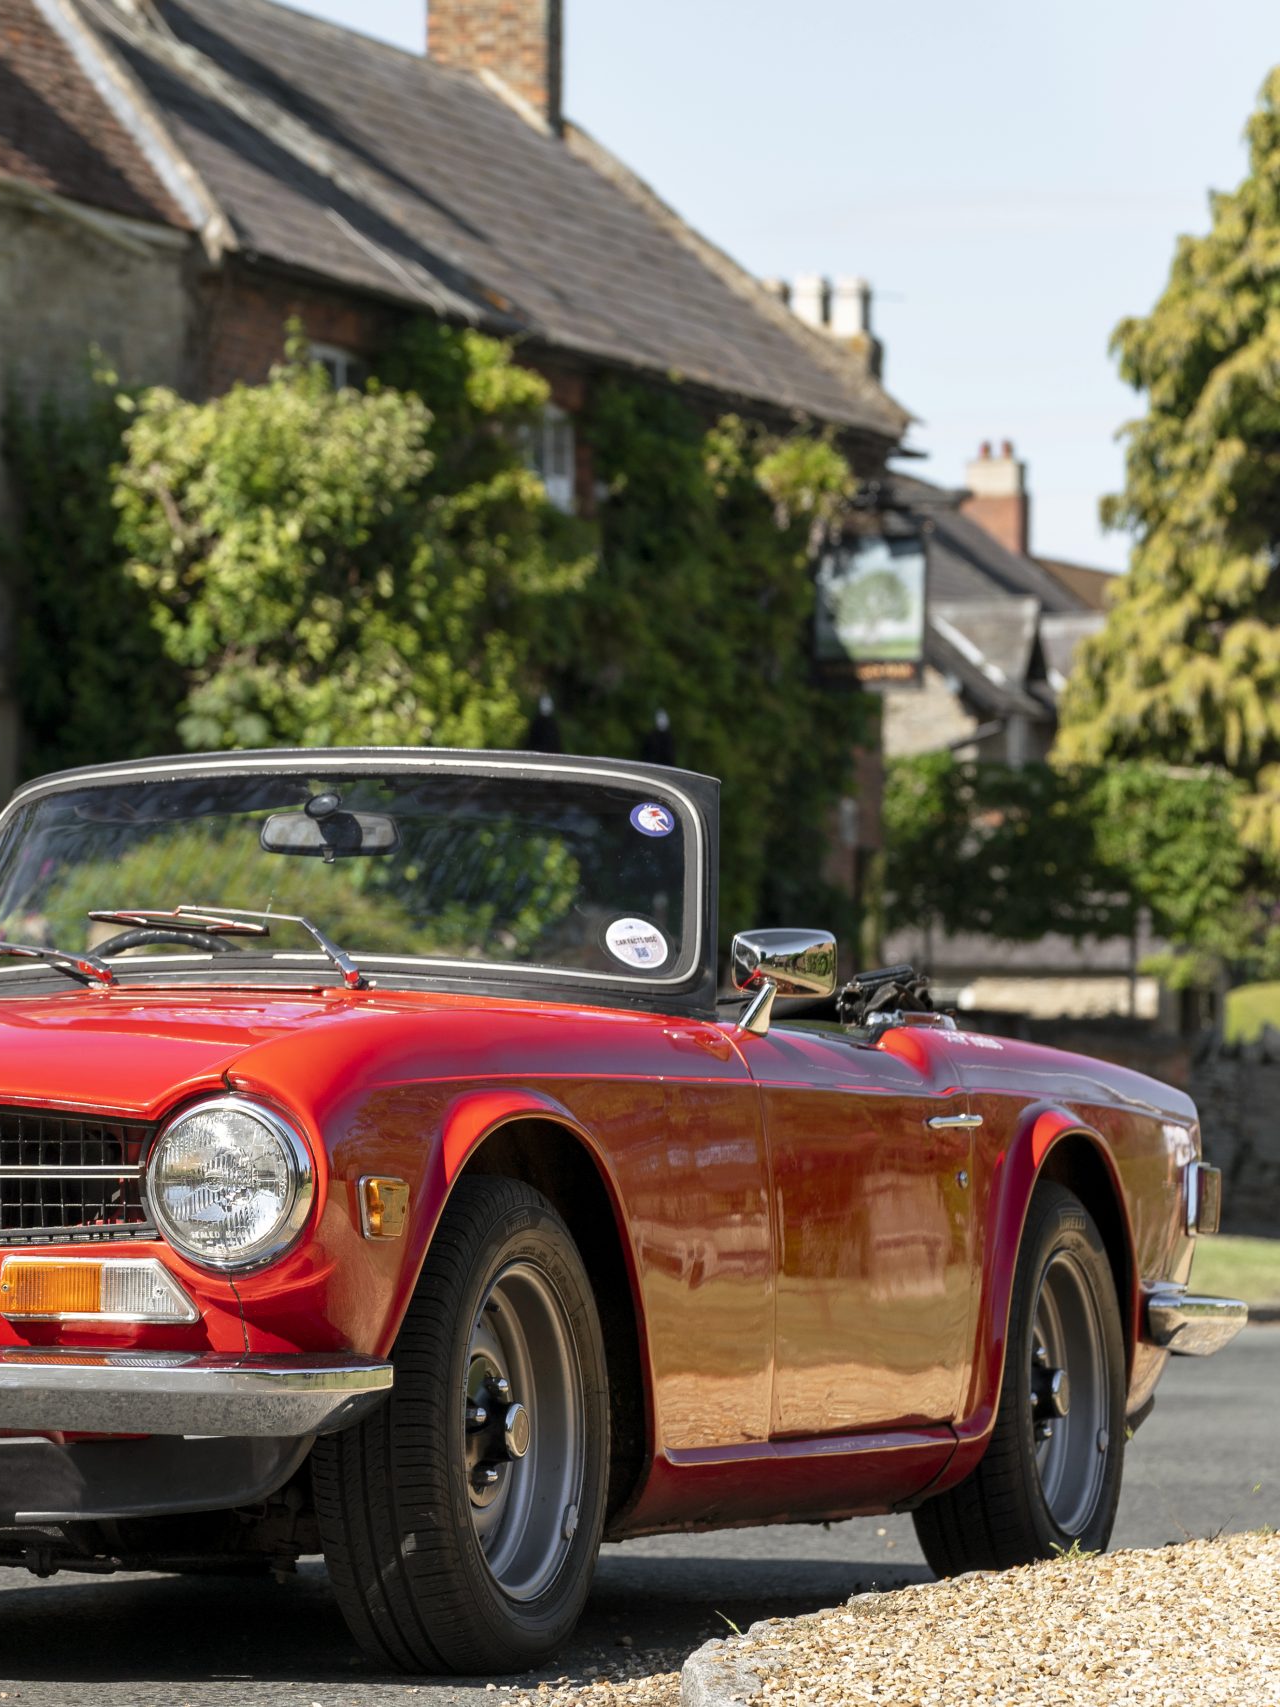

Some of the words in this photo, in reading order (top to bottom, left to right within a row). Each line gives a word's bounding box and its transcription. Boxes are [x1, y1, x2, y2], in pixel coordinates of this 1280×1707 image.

[627, 936, 644, 945] FACTS
[503, 1210, 531, 1236] PIRELLI
[191, 1231, 220, 1239] SEALED
